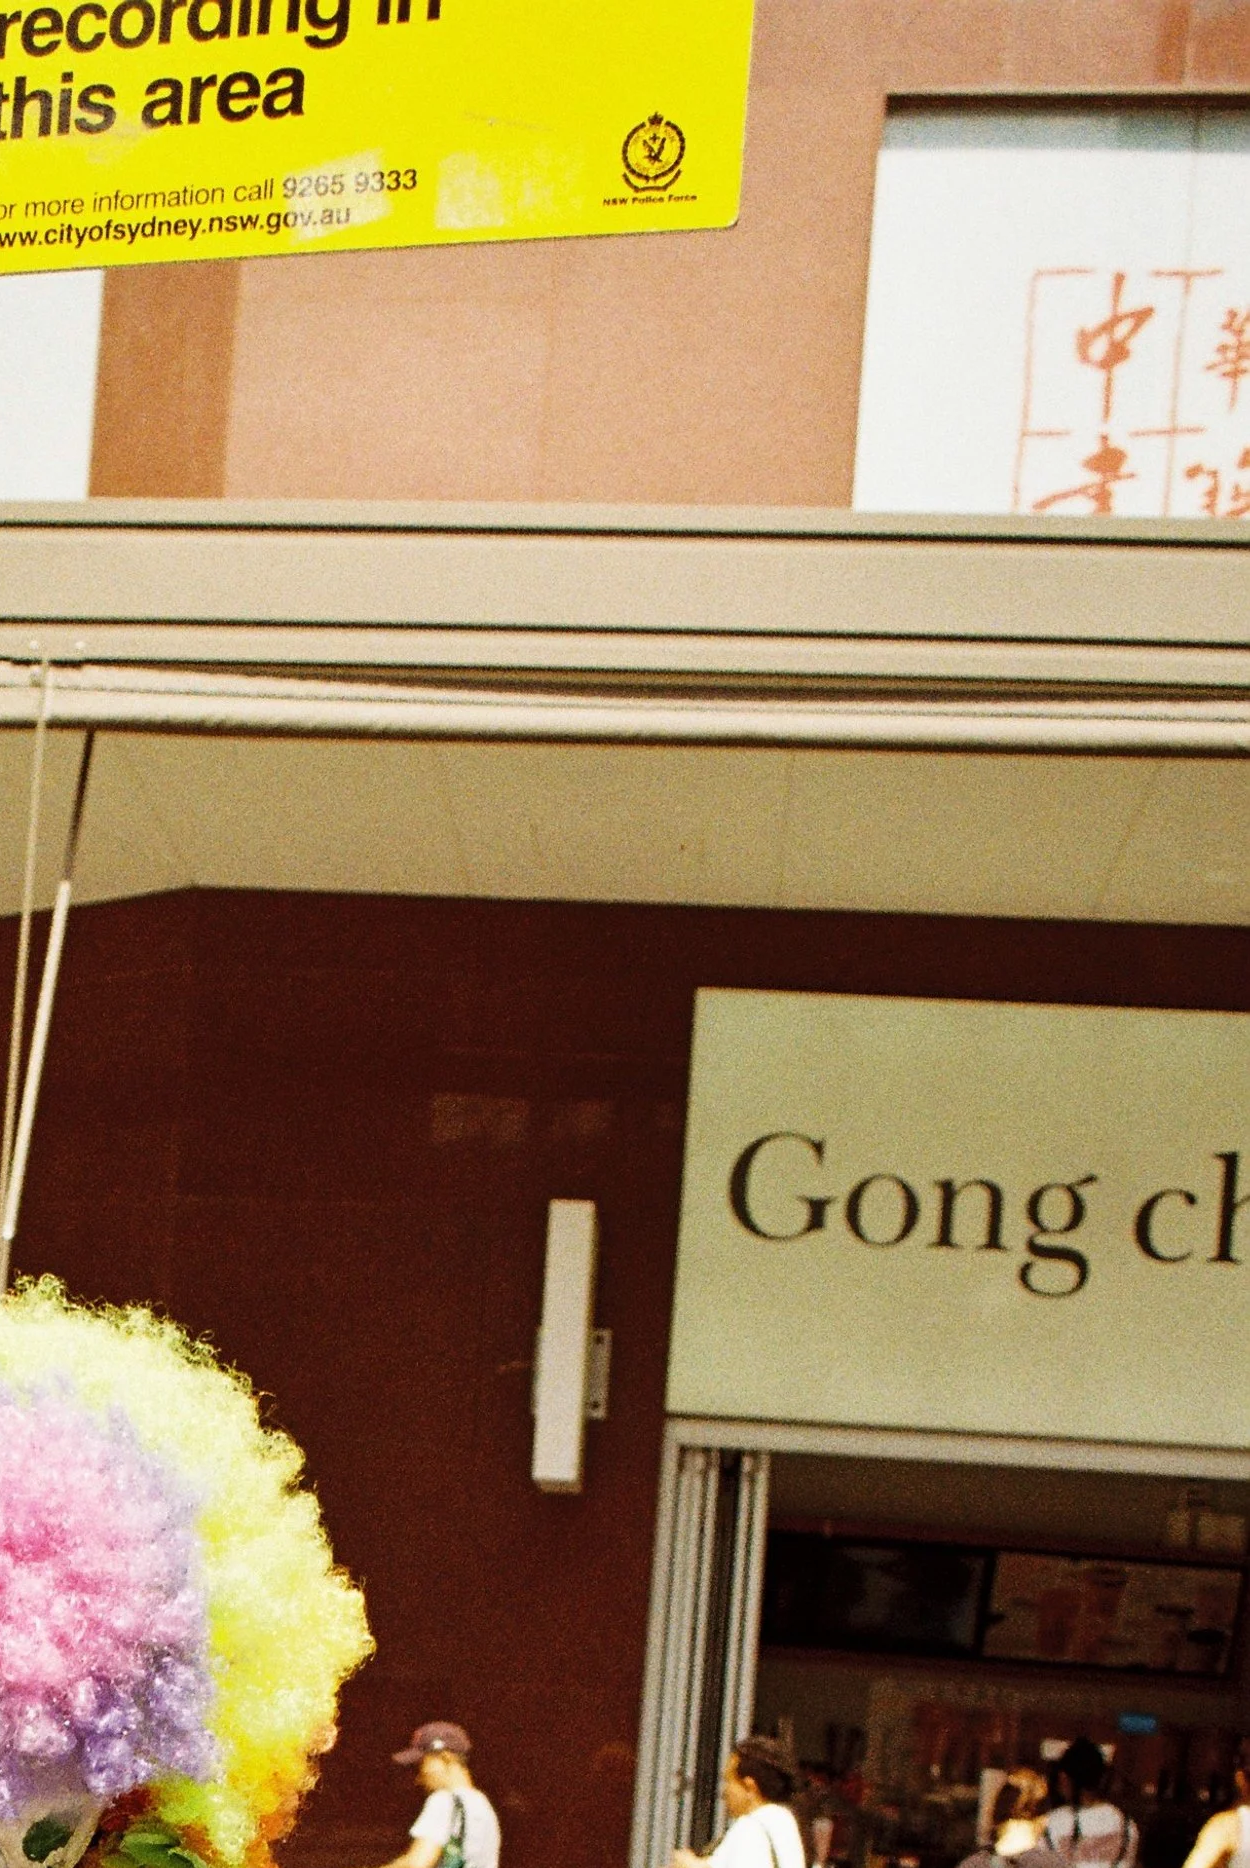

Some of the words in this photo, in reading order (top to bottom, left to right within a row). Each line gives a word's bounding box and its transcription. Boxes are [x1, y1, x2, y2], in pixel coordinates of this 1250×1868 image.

[142, 67, 305, 128] area
[24, 198, 84, 219] more
[93, 183, 225, 212] information
[233, 178, 274, 203] call
[283, 174, 345, 199] 9265
[354, 168, 418, 194] 9333
[602, 197, 629, 206] NSW
[631, 195, 665, 204] Police
[667, 194, 698, 203] Force
[728, 1131, 1098, 1299] Gong
